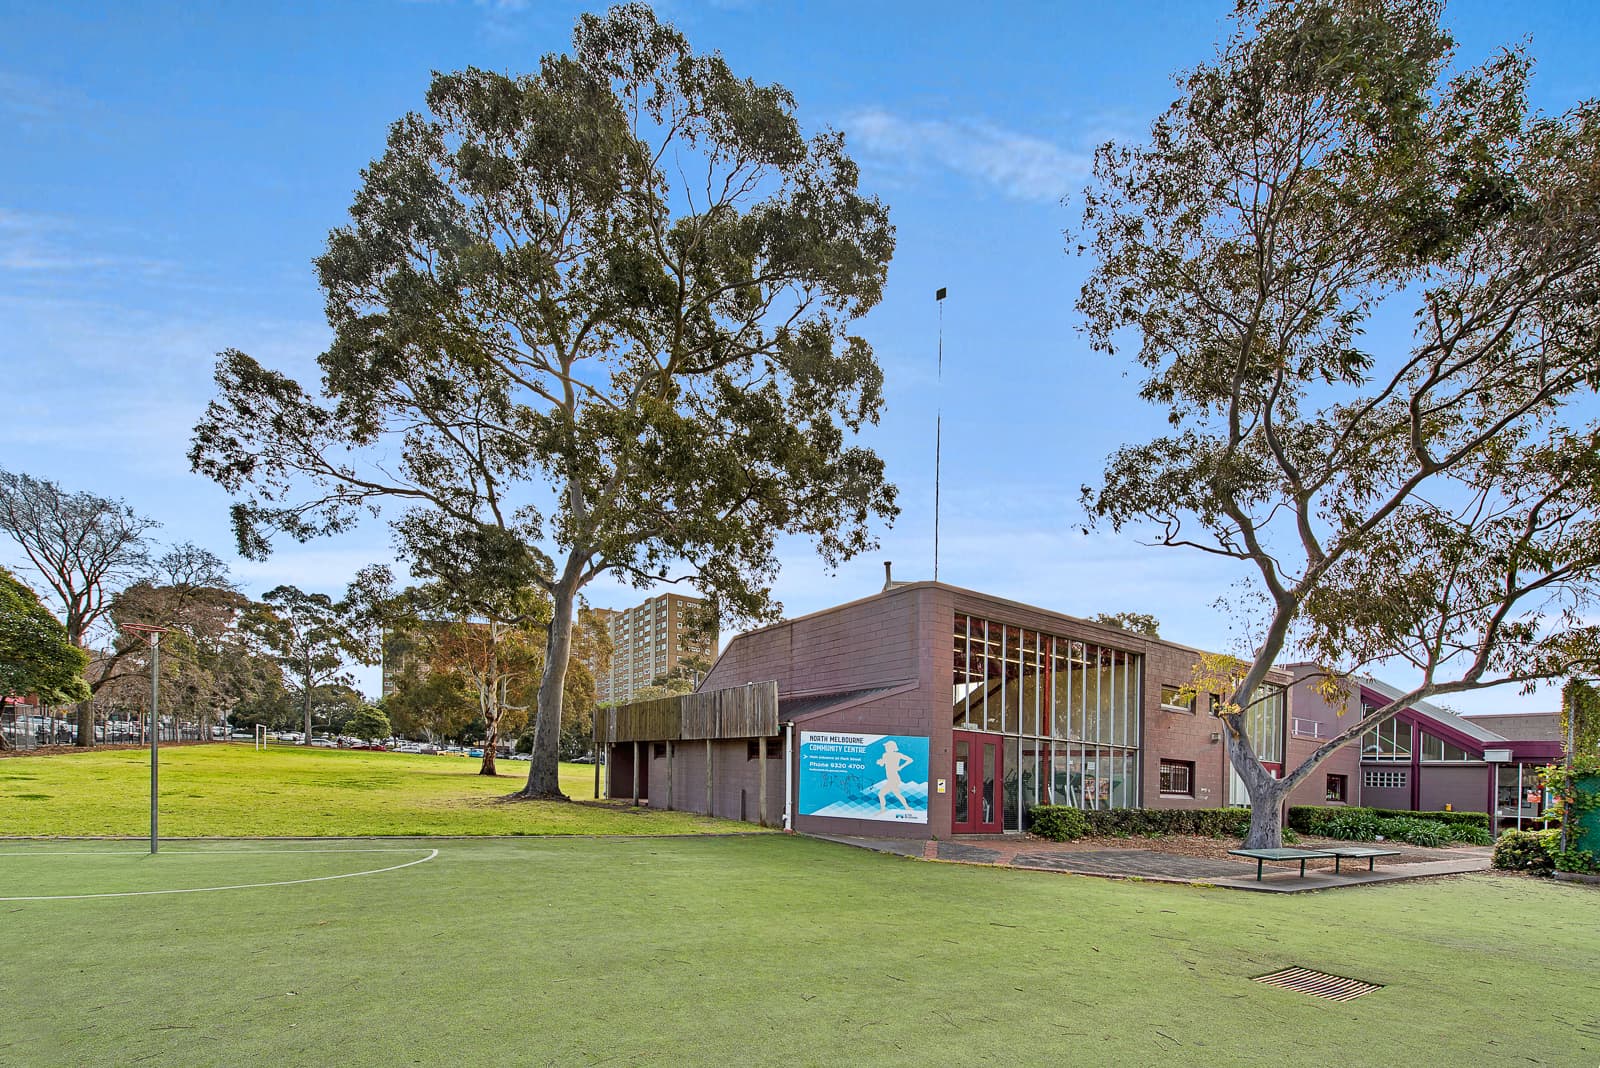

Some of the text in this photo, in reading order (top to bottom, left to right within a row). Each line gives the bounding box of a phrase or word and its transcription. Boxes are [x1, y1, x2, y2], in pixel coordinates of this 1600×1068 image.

[829, 736, 865, 744] MELBOURNE
[809, 744, 867, 754] COMMUNITY CENTRE
